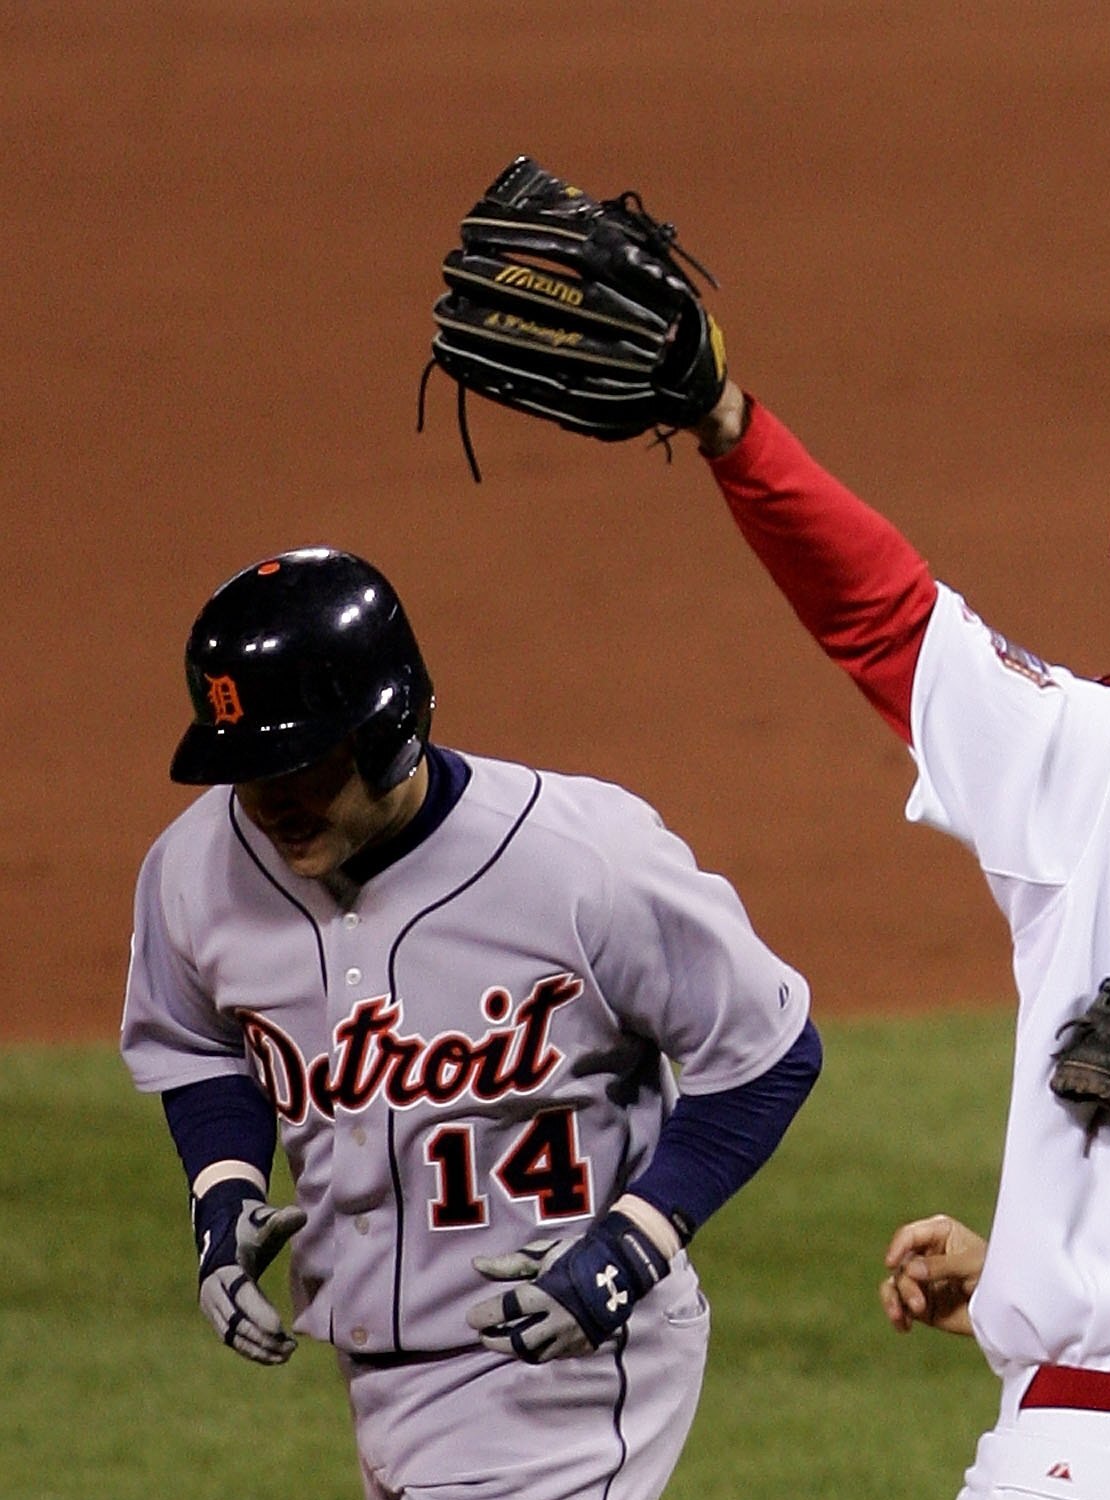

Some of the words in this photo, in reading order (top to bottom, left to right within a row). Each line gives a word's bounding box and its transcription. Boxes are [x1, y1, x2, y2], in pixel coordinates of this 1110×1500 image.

[204, 673, 244, 725] D
[236, 973, 584, 1126] Detroit
[424, 1106, 596, 1231] 14
